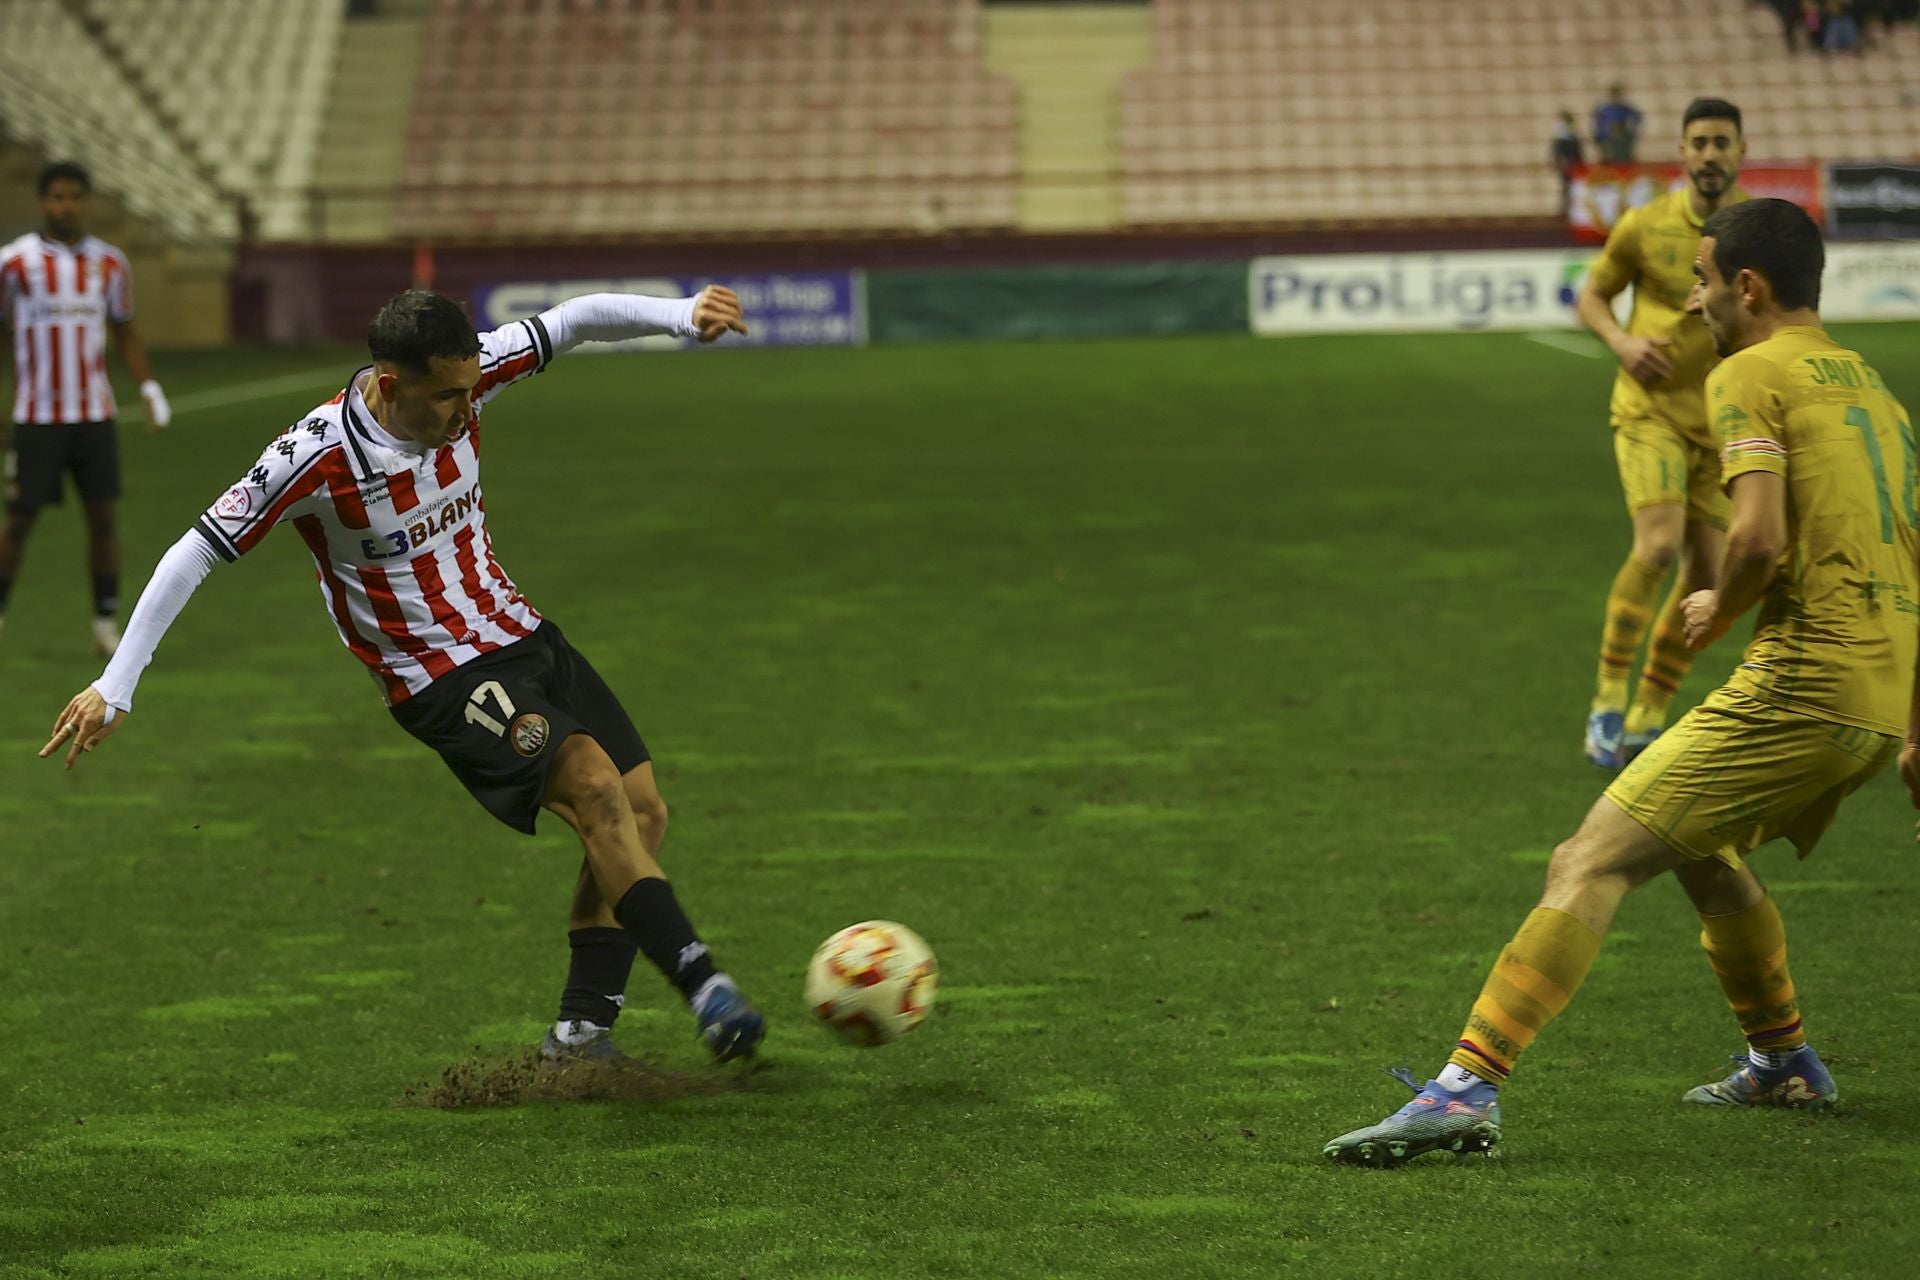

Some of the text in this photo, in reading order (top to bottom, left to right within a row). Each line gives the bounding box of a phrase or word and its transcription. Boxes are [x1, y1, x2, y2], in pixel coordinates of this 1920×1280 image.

[1261, 255, 1536, 329] ProLiga
[1803, 357, 1863, 388] JAVI
[404, 495, 449, 527] embalajes
[464, 681, 517, 738] 17
